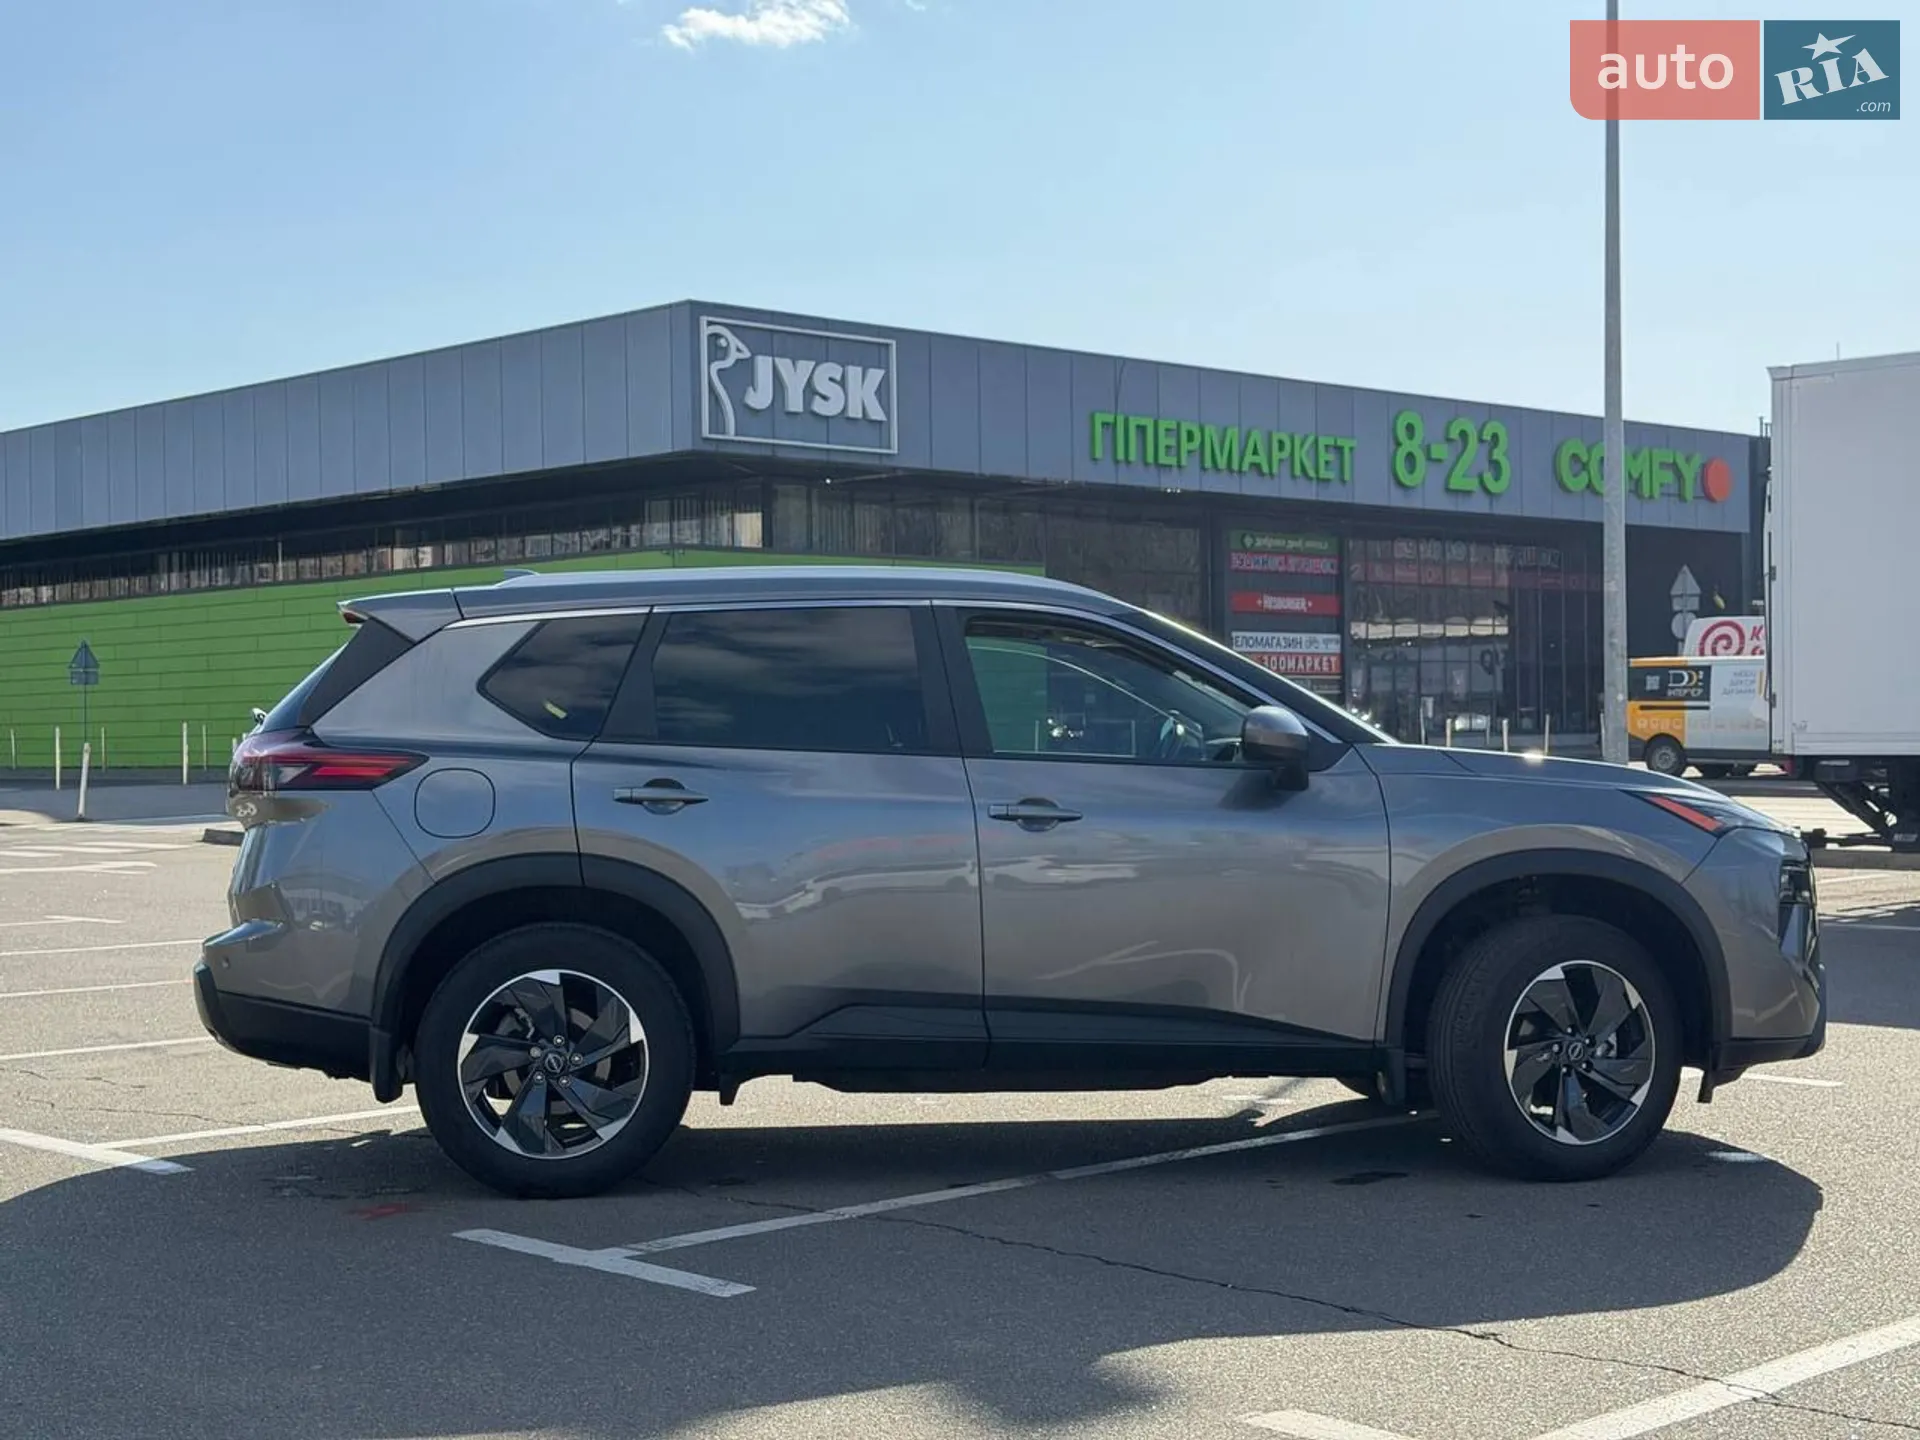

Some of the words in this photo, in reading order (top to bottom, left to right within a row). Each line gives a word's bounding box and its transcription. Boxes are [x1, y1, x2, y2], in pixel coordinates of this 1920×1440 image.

[743, 354, 888, 422] JYSK
[1090, 411, 1357, 482] ГІПЕРМАРКЕТ
[1394, 409, 1512, 494] 8-23
